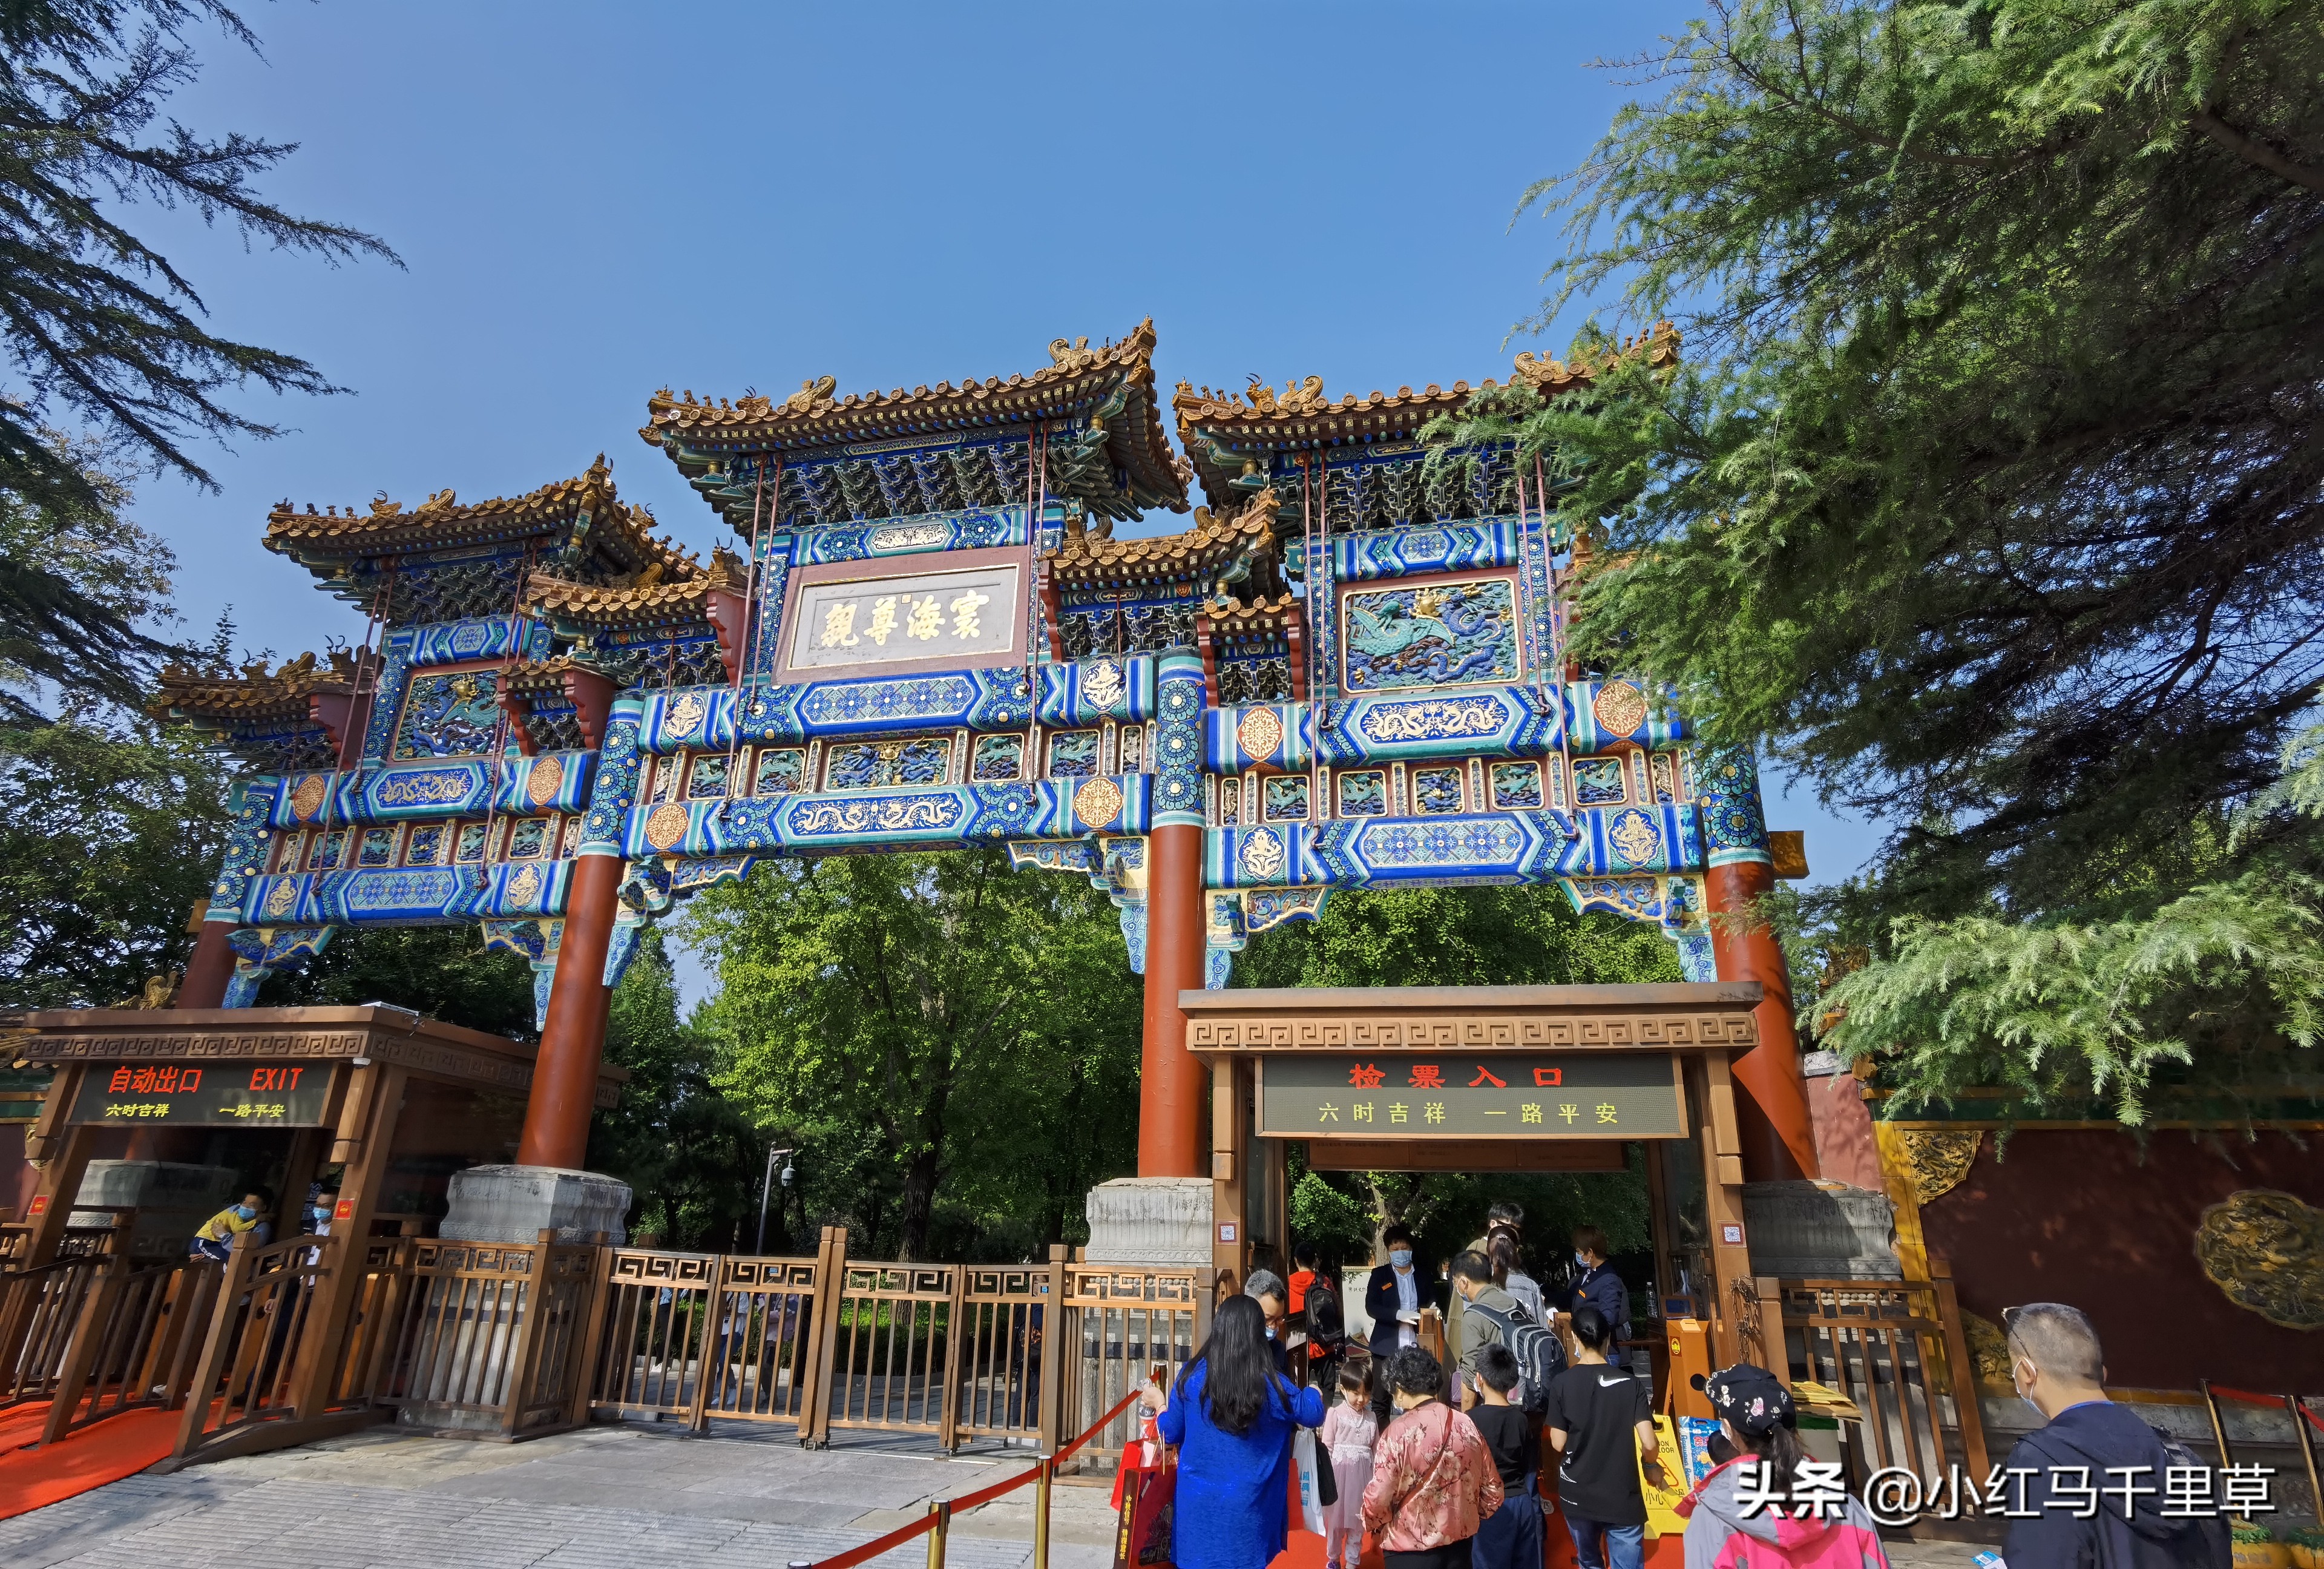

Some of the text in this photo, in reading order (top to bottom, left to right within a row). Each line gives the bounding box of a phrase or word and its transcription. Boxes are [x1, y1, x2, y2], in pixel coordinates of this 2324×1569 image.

[108, 1066, 304, 1094] 自动出口 EXIT
[1348, 1064, 1563, 1090] 检票入口
[105, 1103, 286, 1119] 六时吉祥 一路平安
[1319, 1102, 1618, 1125] 六时吉祥 一路平安
